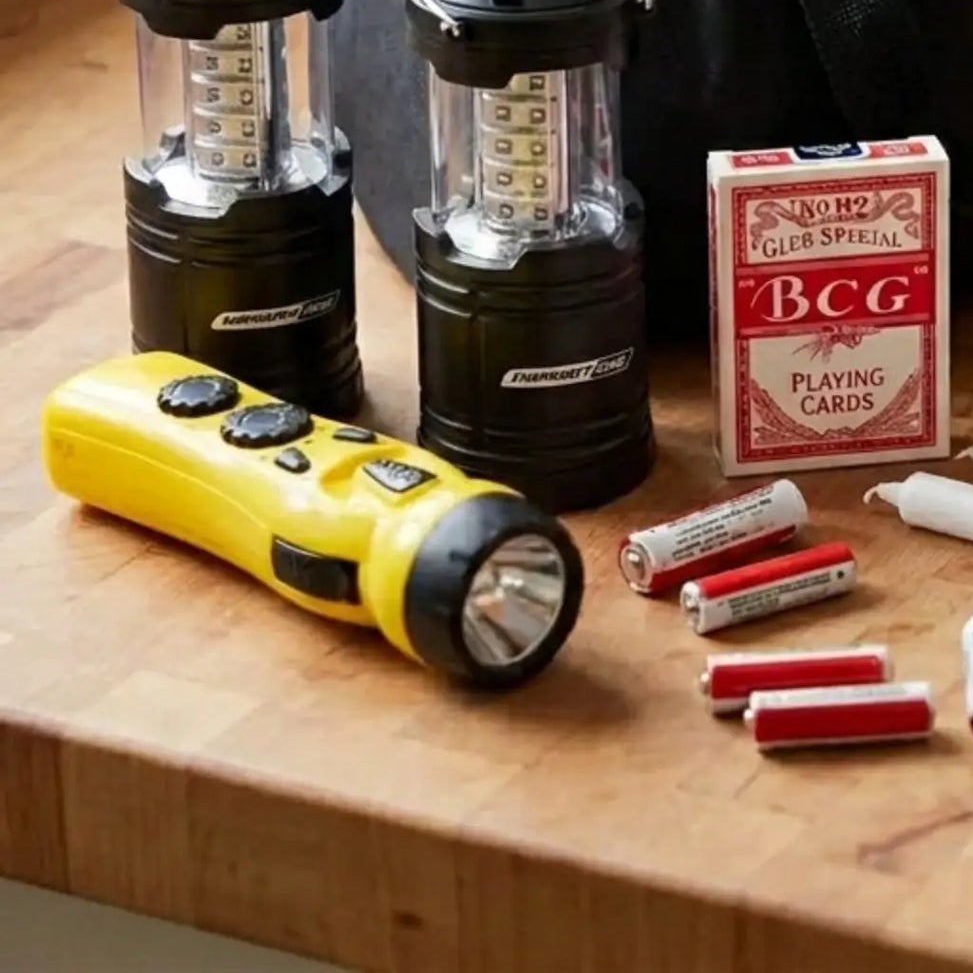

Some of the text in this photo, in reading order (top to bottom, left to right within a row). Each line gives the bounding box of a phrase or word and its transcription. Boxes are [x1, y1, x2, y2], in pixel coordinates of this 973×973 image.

[750, 274, 911, 322] BCG
[791, 367, 886, 393] PLAYING
[800, 392, 875, 416] CARDS
